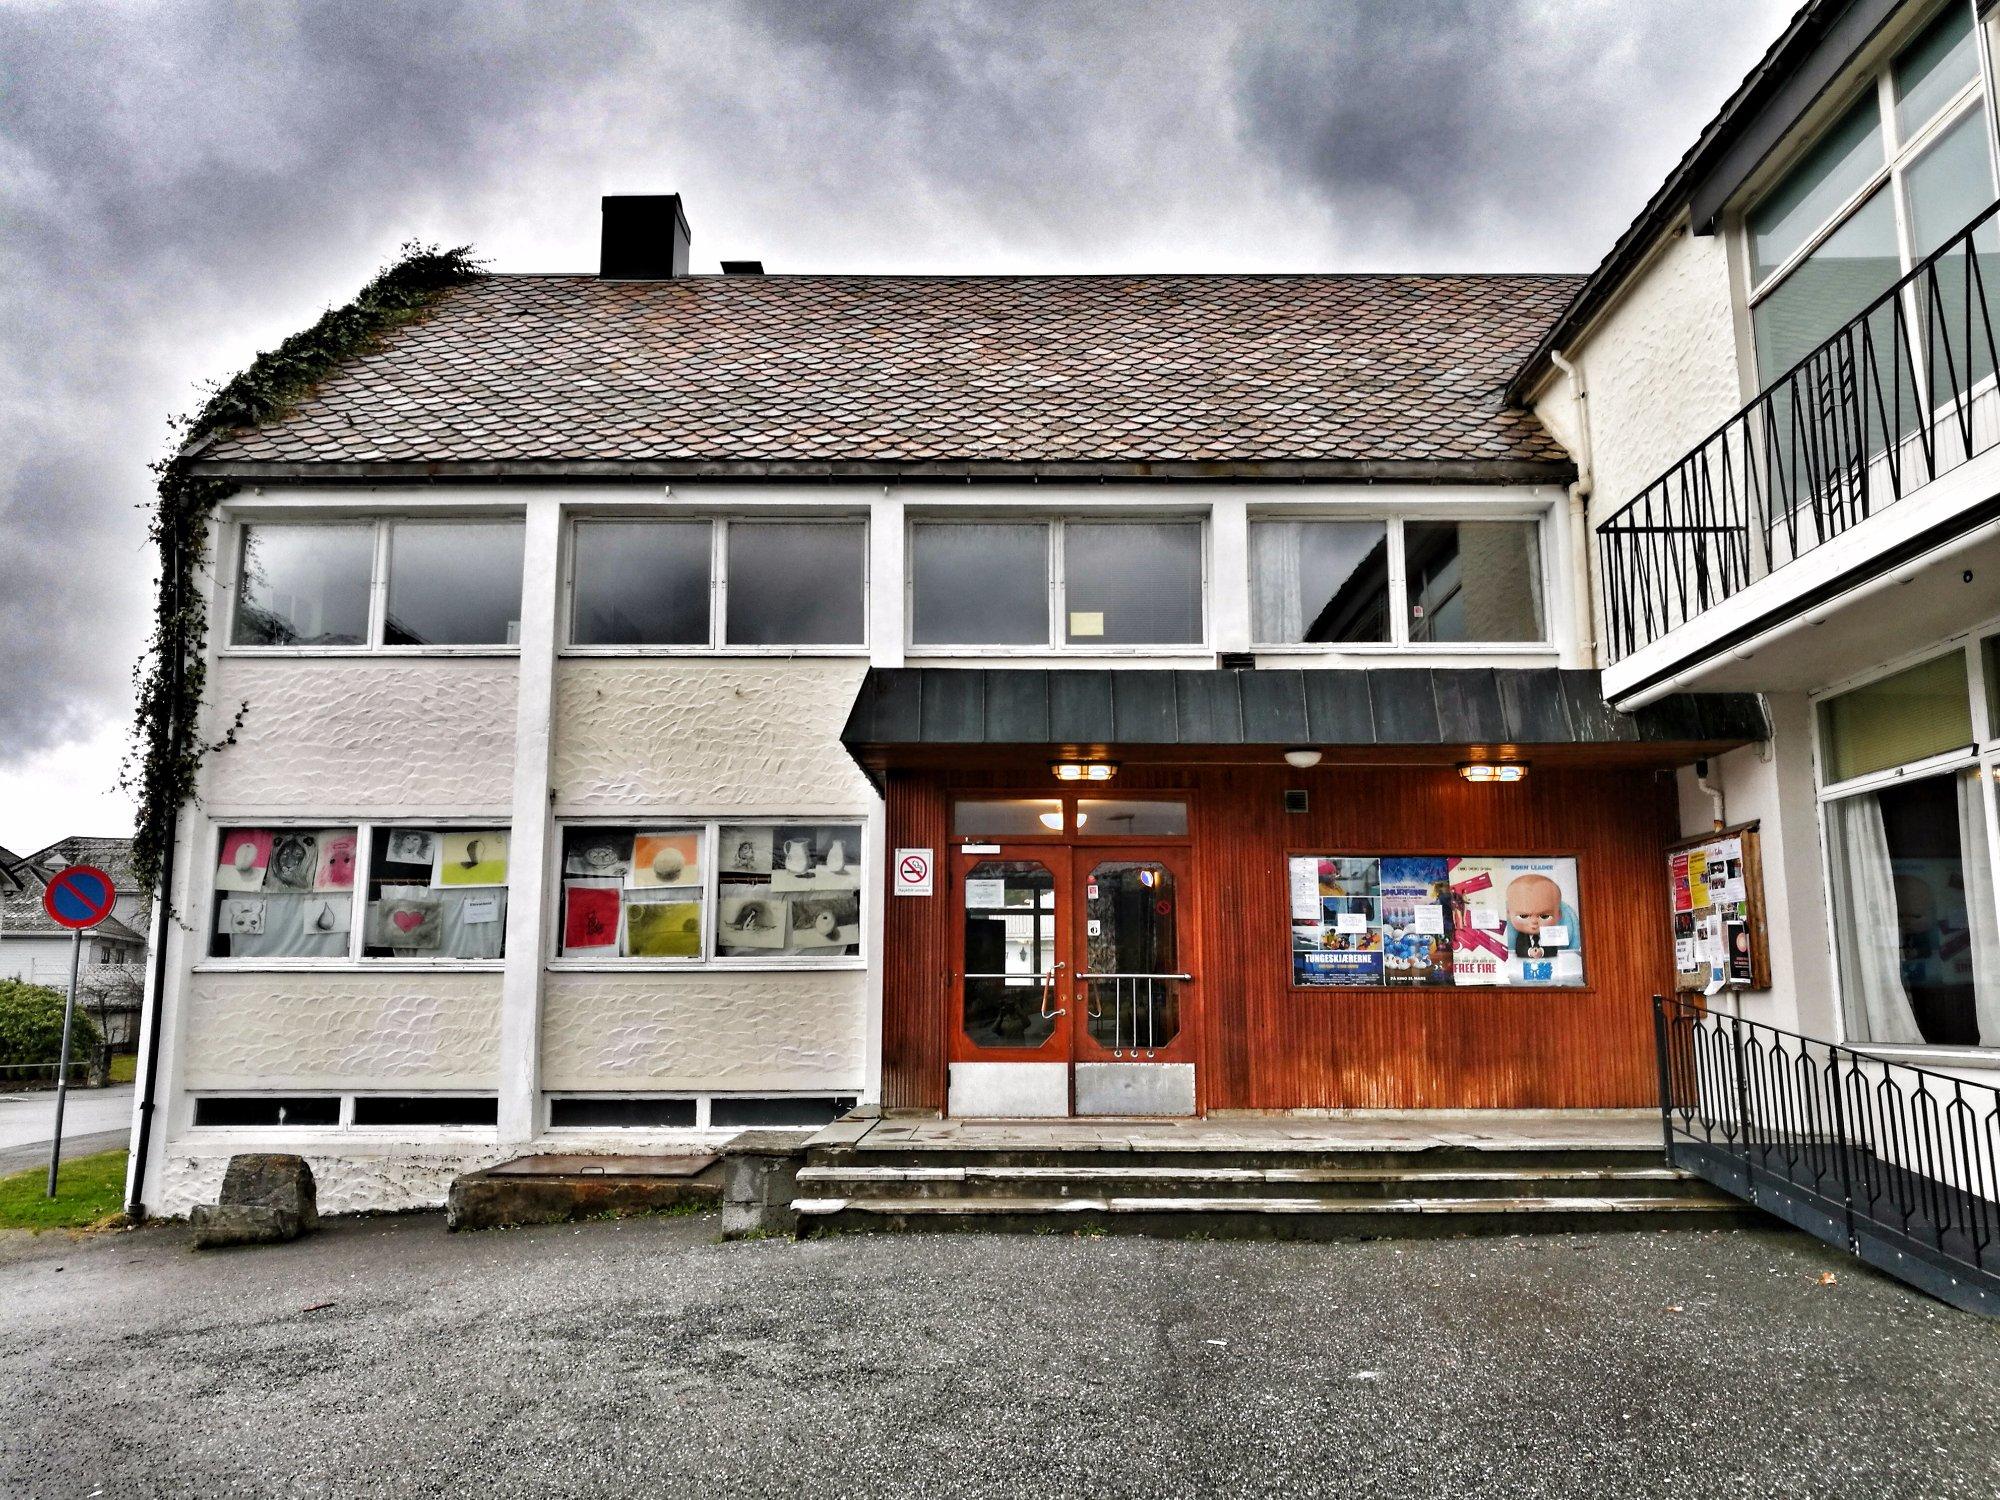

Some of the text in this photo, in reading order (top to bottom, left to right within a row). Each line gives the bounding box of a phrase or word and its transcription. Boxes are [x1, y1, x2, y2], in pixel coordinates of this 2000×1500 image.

[1304, 954, 1371, 963] TUNGESKJÆRERNE
[1453, 963, 1497, 973] FREE FIRE
